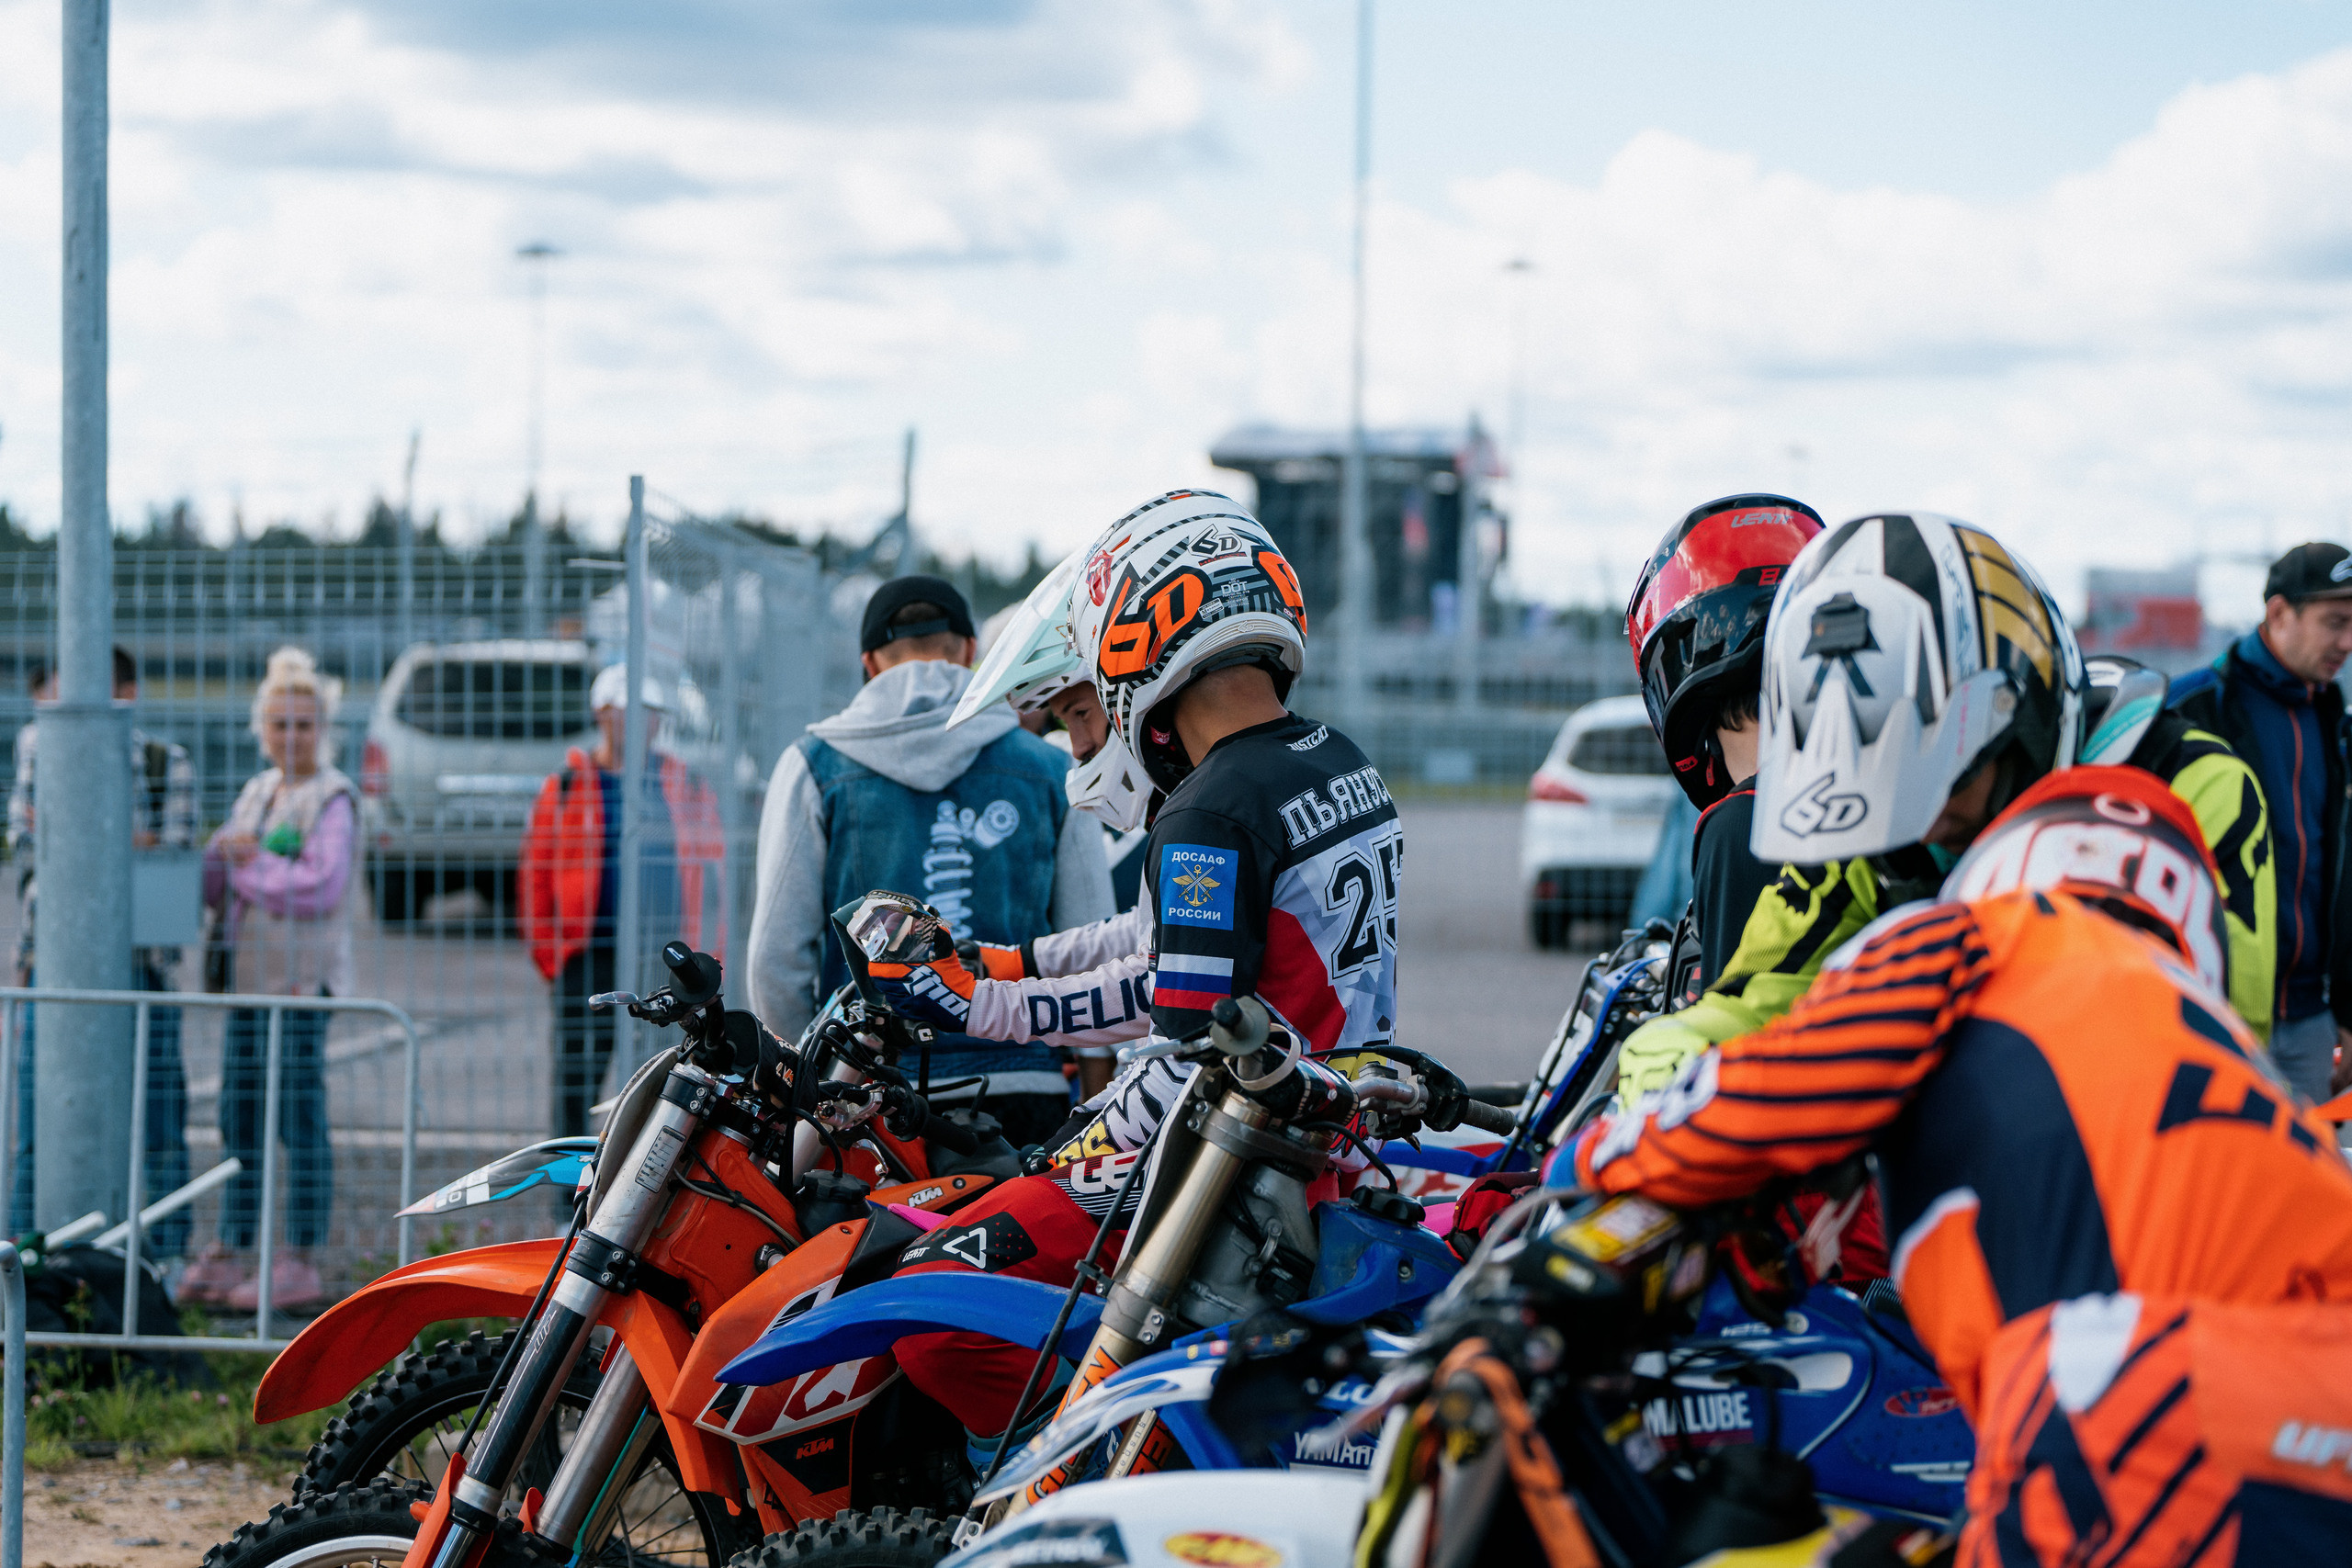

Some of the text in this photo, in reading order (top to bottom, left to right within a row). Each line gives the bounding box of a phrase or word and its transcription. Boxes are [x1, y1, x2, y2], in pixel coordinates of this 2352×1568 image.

[1221, 581, 1248, 594] DOT
[1278, 764, 1393, 850] ПЬЯНУС
[1781, 770, 1867, 838] 6D
[1171, 852, 1226, 865] ДОСААФ
[1168, 907, 1221, 921] РОССИИ
[1324, 830, 1404, 980] 25
[908, 1186, 944, 1208] KTM
[902, 1247, 931, 1262] LEATT
[796, 1438, 834, 1461] KTM
